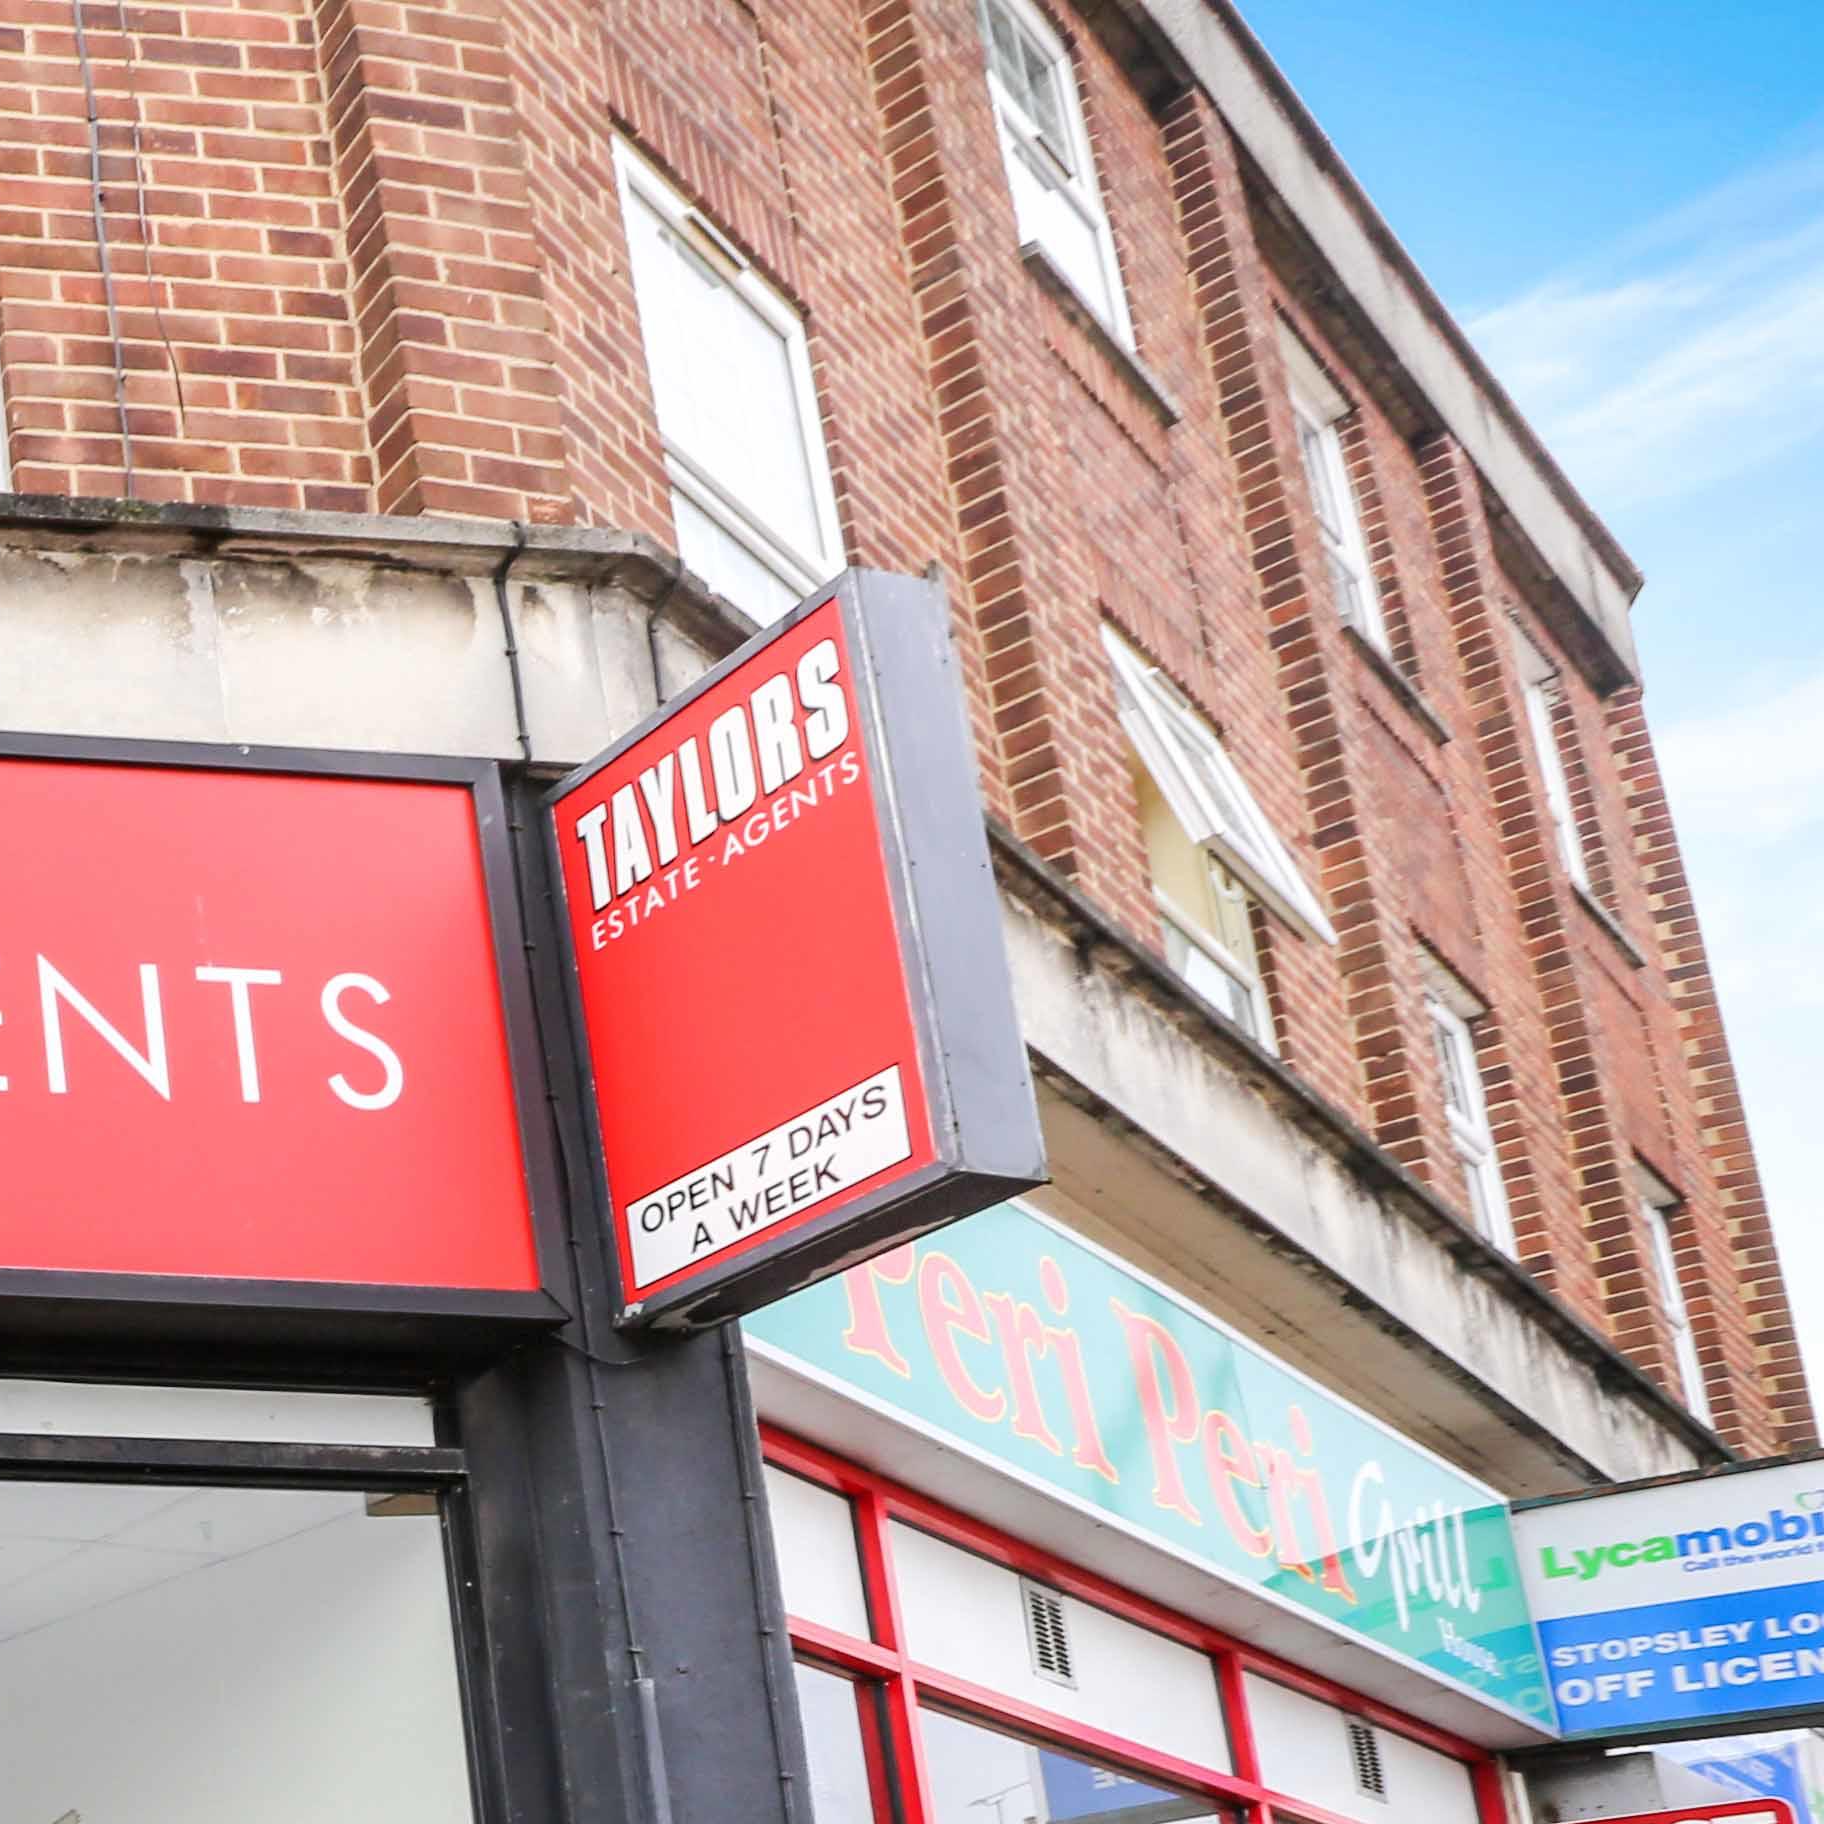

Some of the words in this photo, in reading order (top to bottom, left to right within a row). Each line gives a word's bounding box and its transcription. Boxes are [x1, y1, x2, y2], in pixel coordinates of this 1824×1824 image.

[575, 638, 850, 913] TAYLORS
[590, 860, 702, 951] ESTATE
[721, 752, 860, 866] AGENTS
[641, 1162, 736, 1235] OPEN
[751, 1144, 770, 1178] 7
[787, 1085, 887, 1160] DAYS
[690, 1223, 713, 1254] A
[730, 1157, 841, 1230] WEEK
[842, 1243, 1120, 1484] Peri
[1110, 1299, 1357, 1606] Peri
[1352, 1461, 1481, 1632] Grill
[1552, 1620, 1756, 1668] STOPSLEY
[1555, 1669, 1656, 1707] OFF
